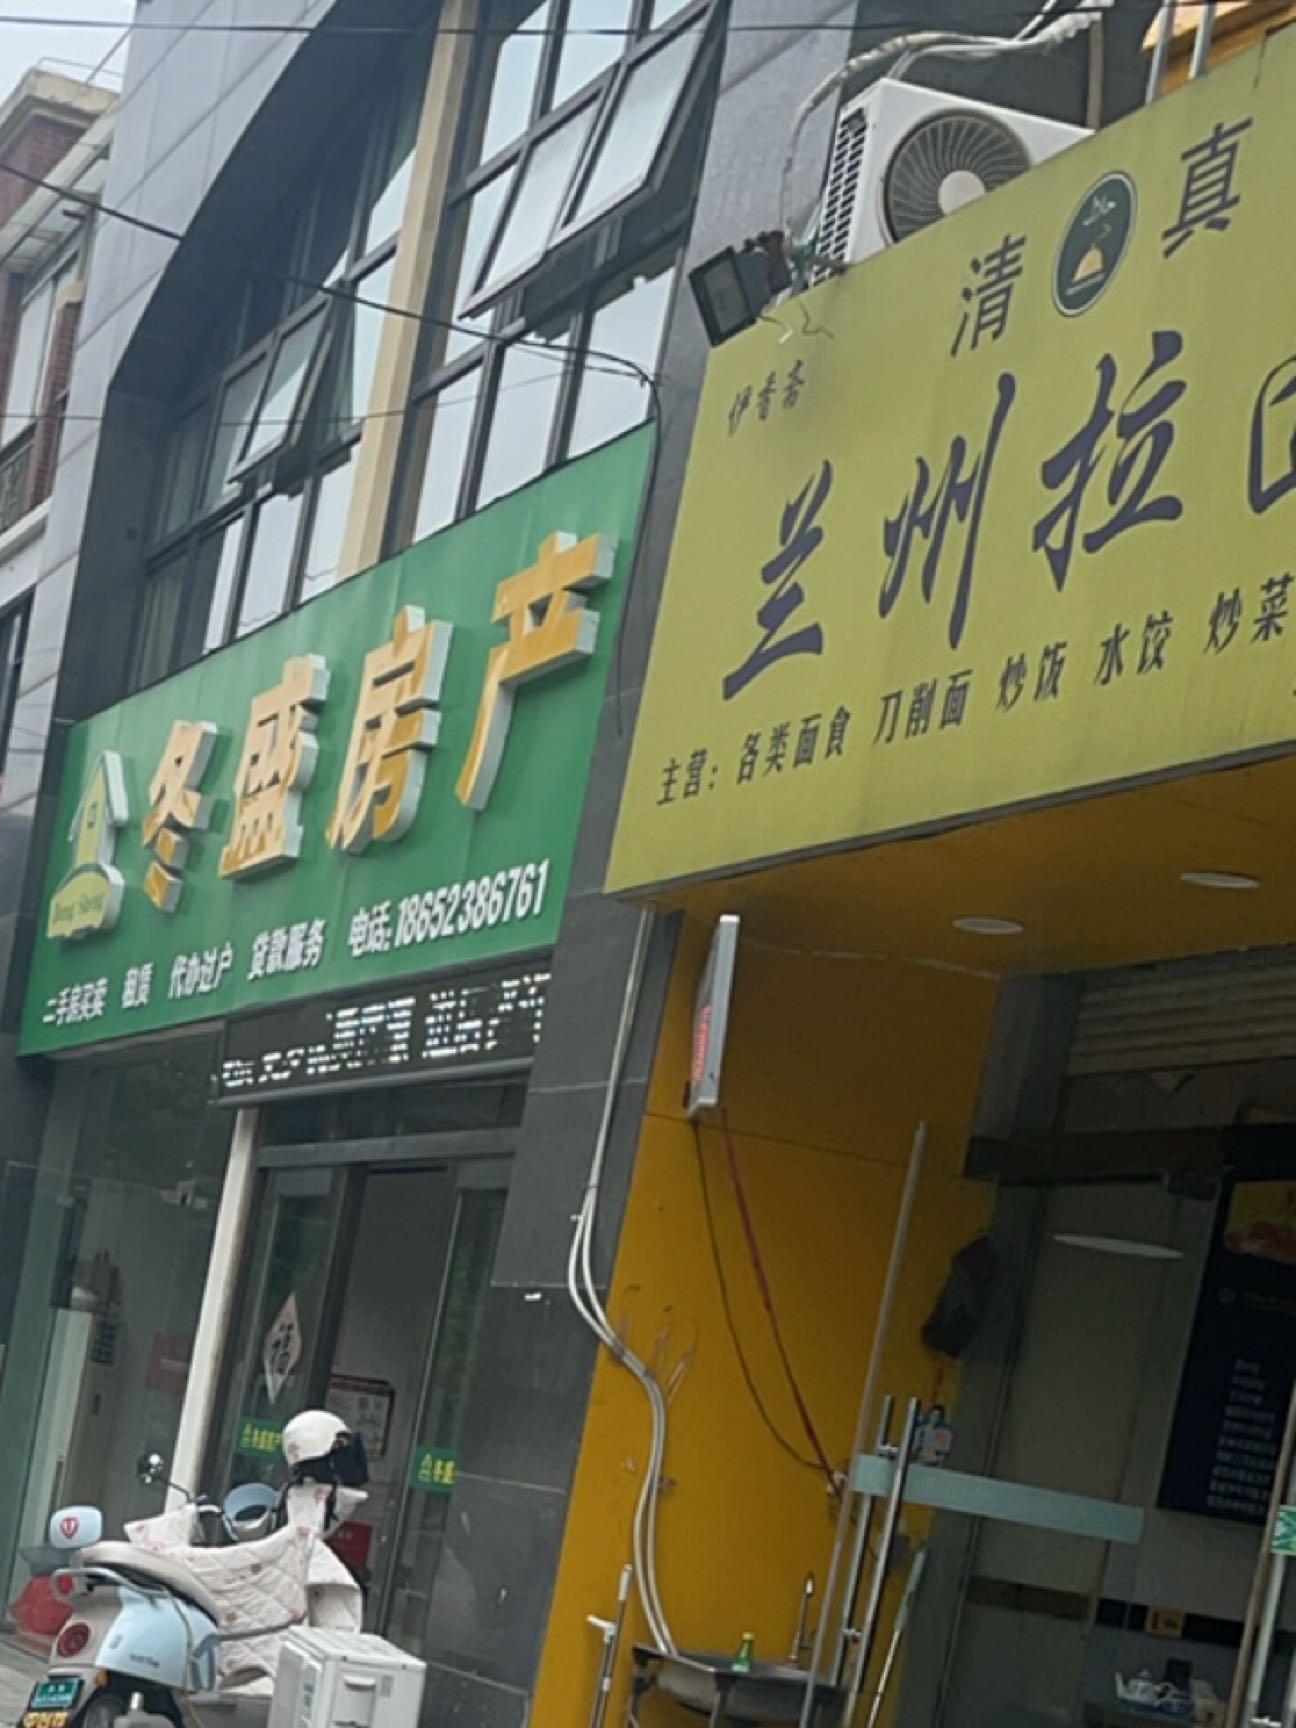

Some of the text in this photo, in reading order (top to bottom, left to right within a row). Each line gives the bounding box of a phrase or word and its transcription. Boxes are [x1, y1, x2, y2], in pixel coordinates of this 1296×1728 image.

[950, 117, 1253, 359] 清 真
[141, 531, 618, 913] 冬盛房产
[874, 669, 972, 745] 刀削面
[996, 640, 1067, 711] 炒饭
[1094, 611, 1174, 686] 水饺
[1203, 571, 1296, 655] 炒菜
